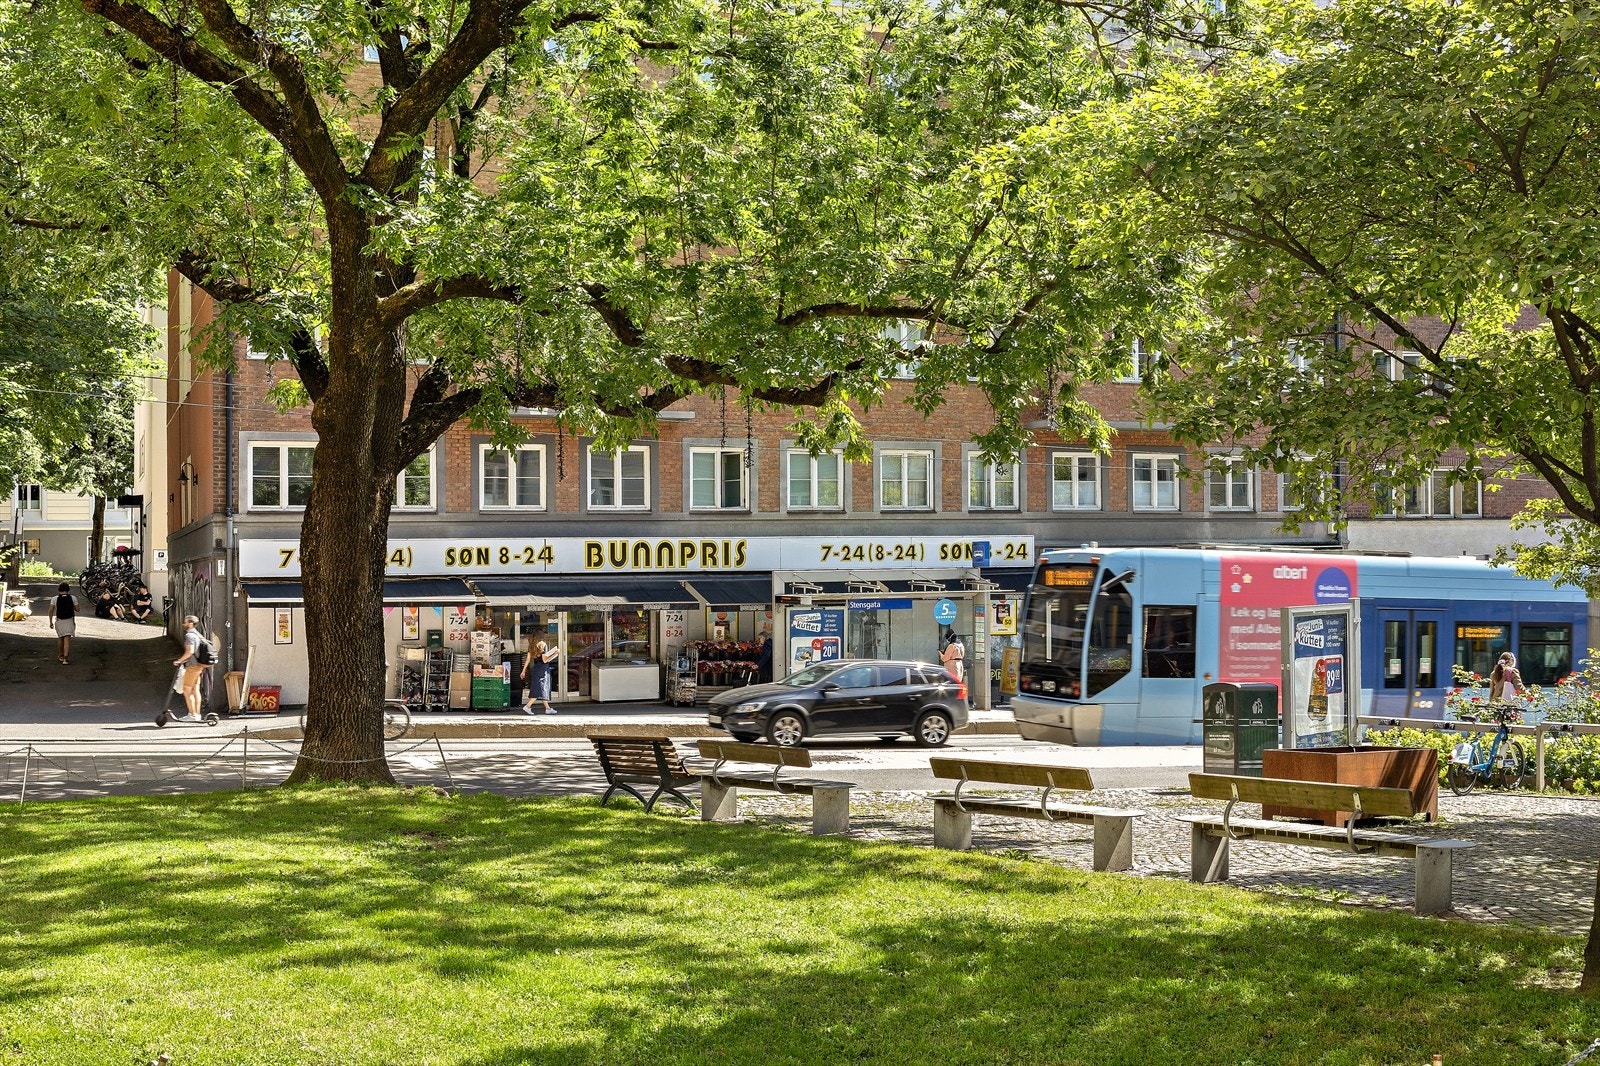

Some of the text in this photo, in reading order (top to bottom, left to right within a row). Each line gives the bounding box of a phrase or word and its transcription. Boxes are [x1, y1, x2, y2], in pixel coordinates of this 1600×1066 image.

[445, 546, 491, 567] SØN
[499, 545, 556, 567] 8-24
[585, 539, 748, 570] BUNNPRIS
[1273, 565, 1308, 579] albert
[850, 601, 881, 609] Stensgata
[941, 603, 950, 616] 5
[665, 614, 683, 622] 7-24
[1230, 607, 1250, 617] Lek
[1251, 609, 1266, 620] og
[449, 616, 469, 625] 7-24
[796, 620, 819, 631] kuttet
[1230, 623, 1254, 634] med
[449, 633, 469, 641] 8-24
[1299, 631, 1323, 648] kuttet
[822, 646, 832, 658] 20
[1326, 670, 1335, 688] 89
